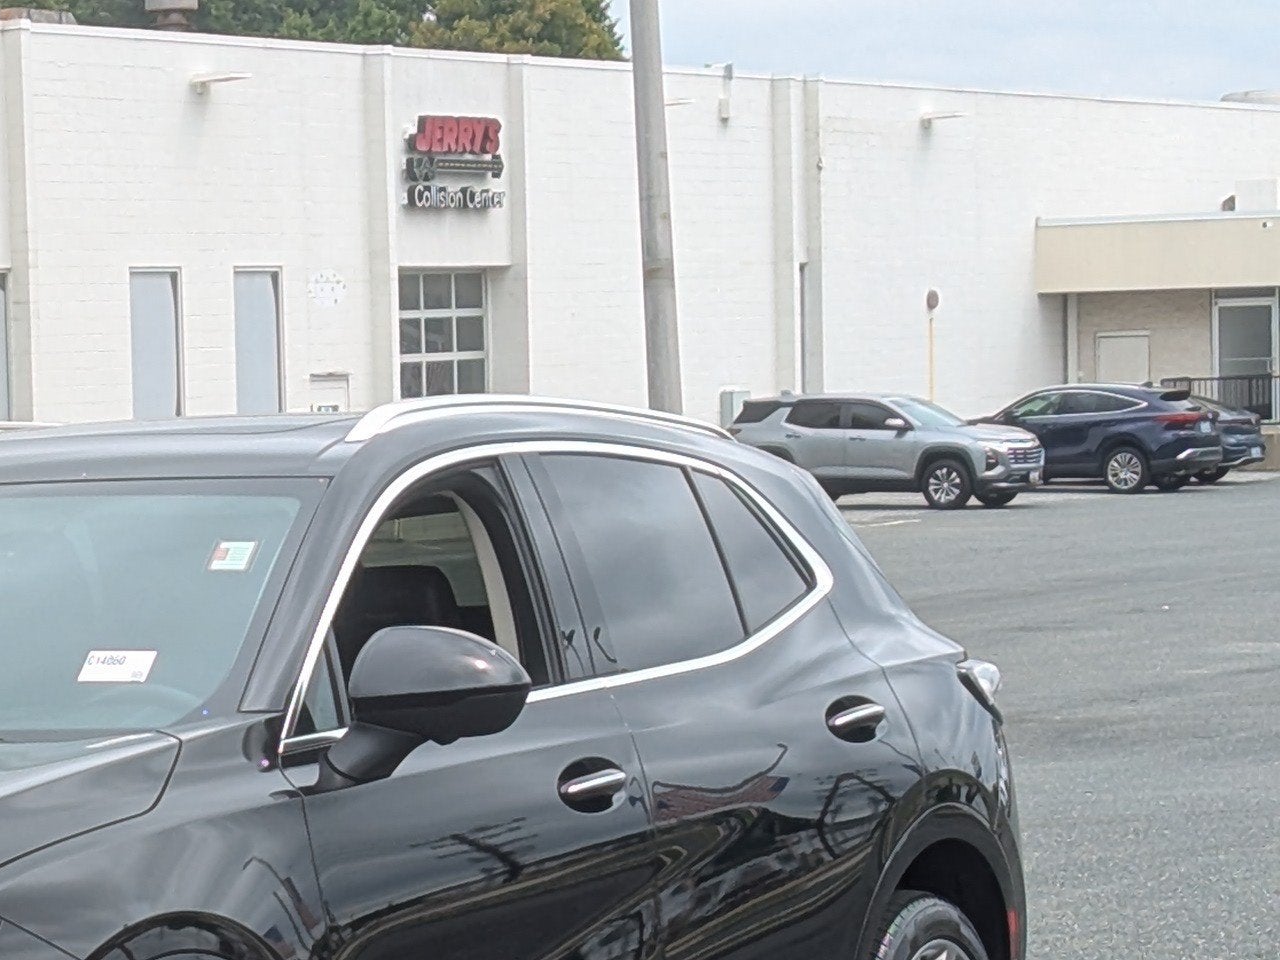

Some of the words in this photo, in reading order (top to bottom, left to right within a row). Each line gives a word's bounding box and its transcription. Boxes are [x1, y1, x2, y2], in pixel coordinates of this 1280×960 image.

[415, 115, 501, 154] JERRY'S
[414, 184, 464, 207] Collision
[466, 186, 505, 208] Center
